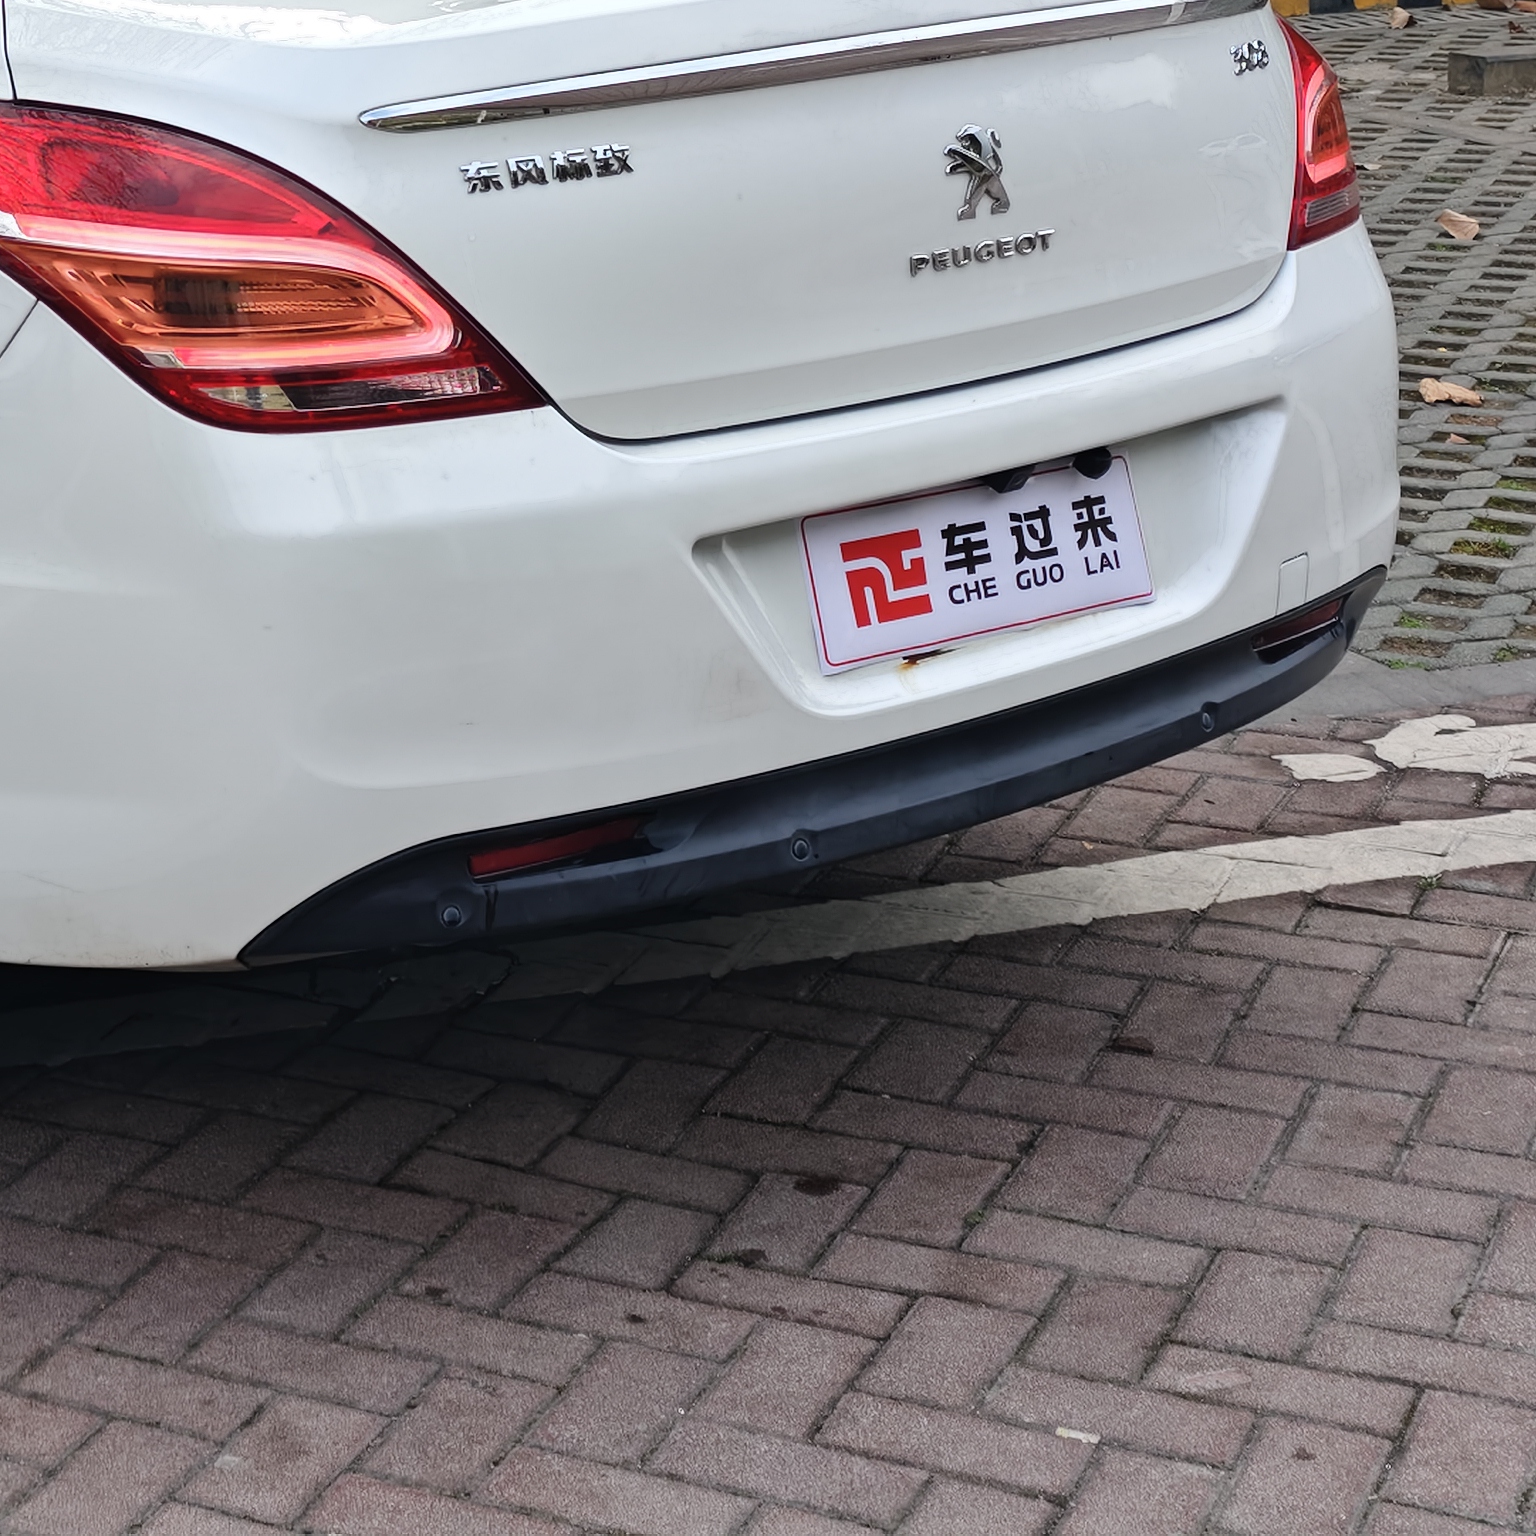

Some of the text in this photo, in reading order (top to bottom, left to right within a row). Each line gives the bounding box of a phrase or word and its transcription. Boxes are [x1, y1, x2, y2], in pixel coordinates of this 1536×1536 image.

[459, 143, 634, 194] 东风标致
[910, 228, 1056, 277] PEUGEOT
[940, 495, 1118, 575] 车过来
[948, 549, 1121, 605] CHE GUO LAI
